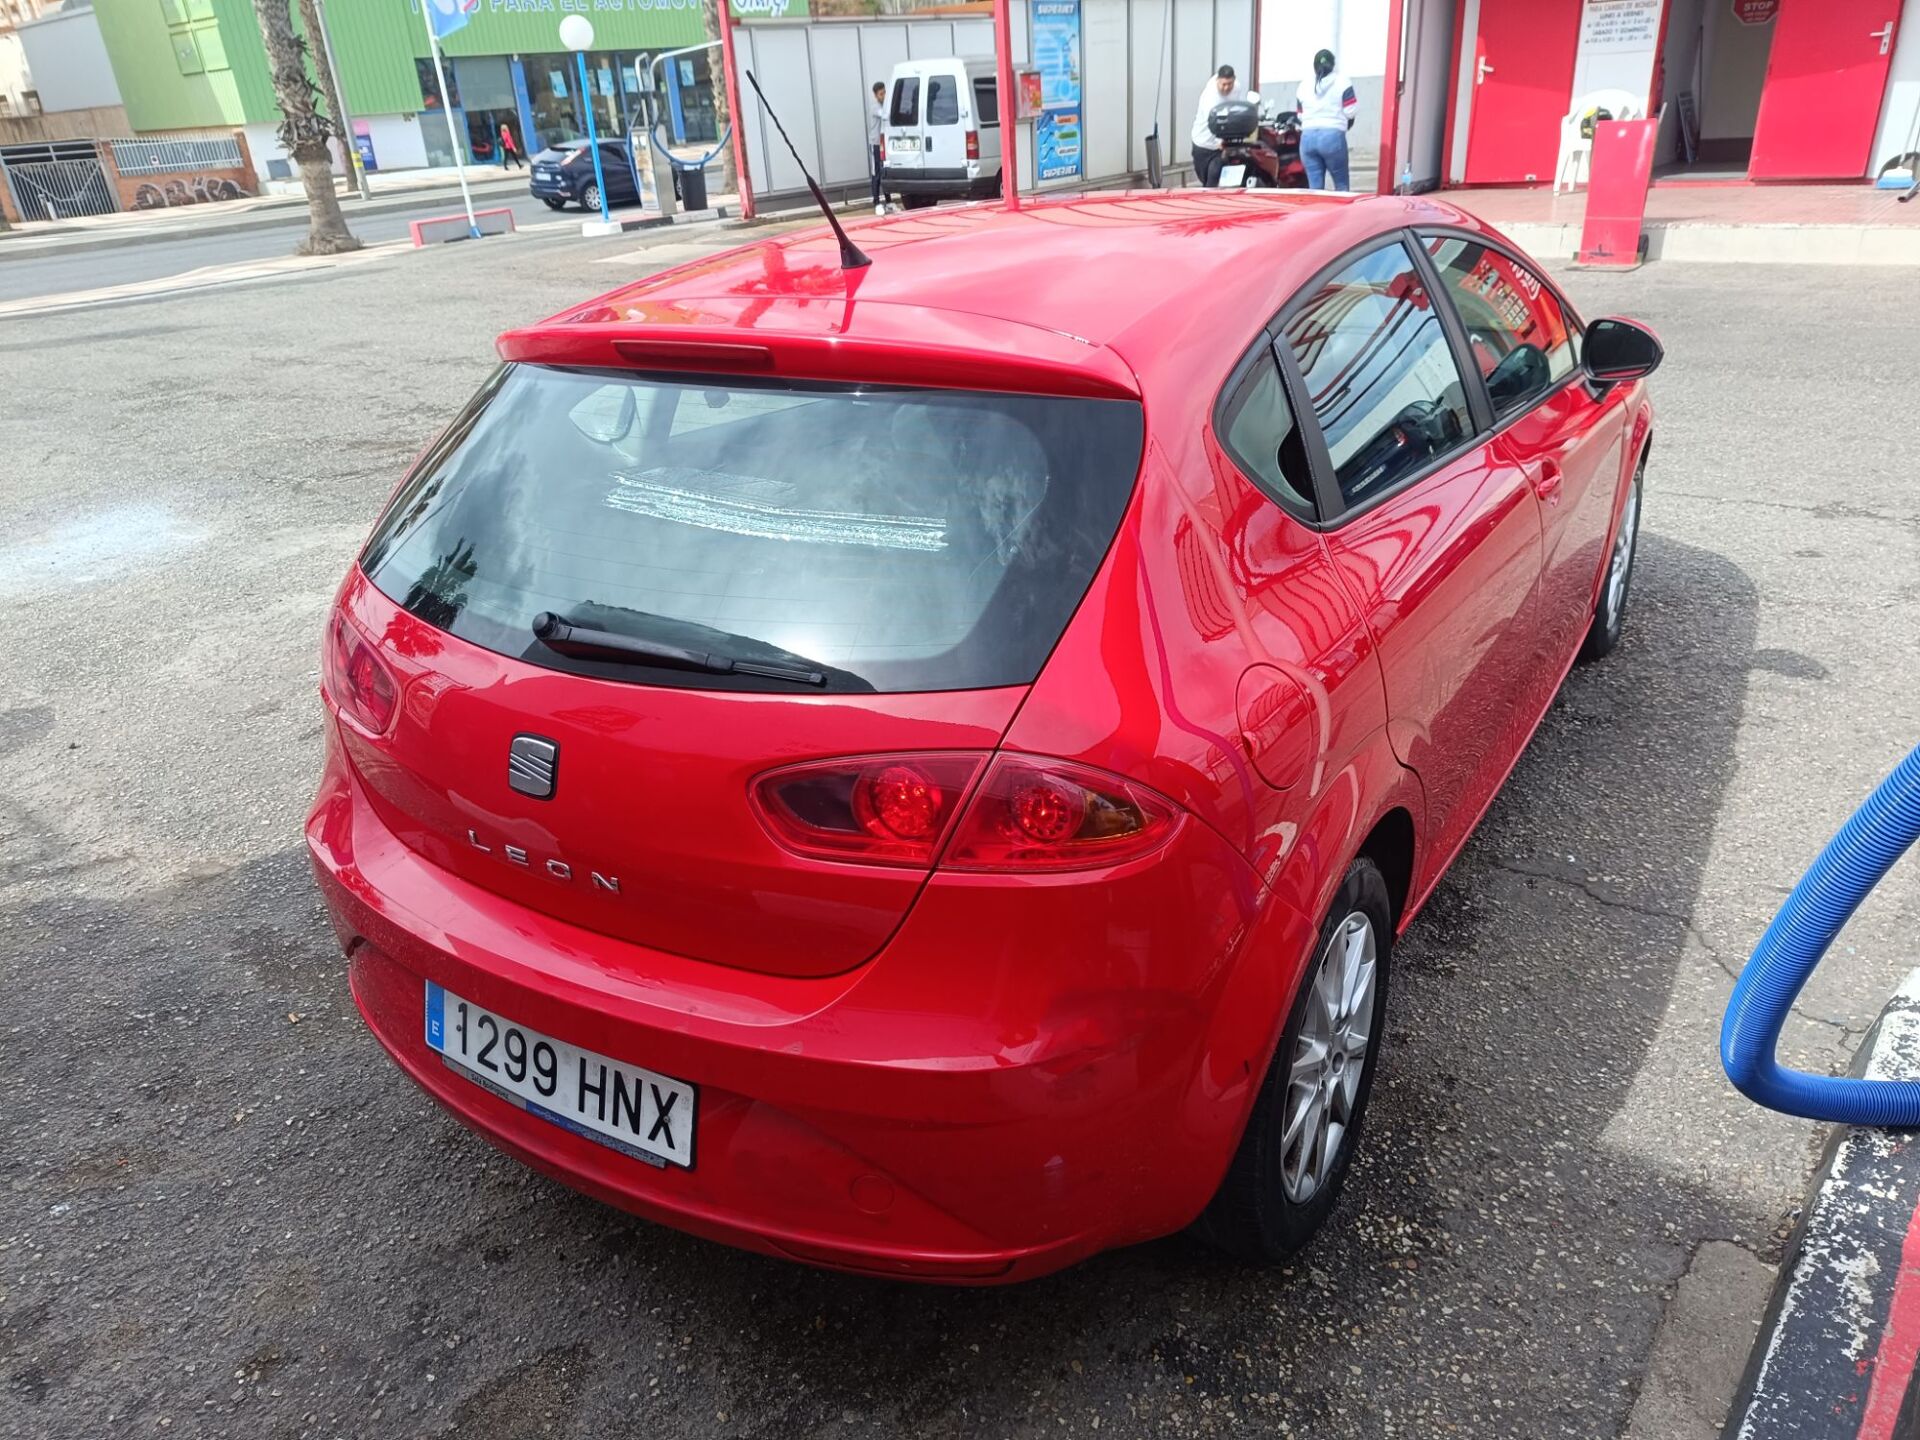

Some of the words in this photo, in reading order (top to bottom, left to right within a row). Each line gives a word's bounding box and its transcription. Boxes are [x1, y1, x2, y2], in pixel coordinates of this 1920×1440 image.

[1037, 4, 1075, 15] SUPERJET
[1743, 1, 1775, 11] STOP
[1043, 165, 1077, 178] SUPERJET
[468, 829, 620, 894] LEON
[431, 1020, 440, 1037] E
[458, 1003, 557, 1097] 1299
[578, 1057, 679, 1150] HNX
